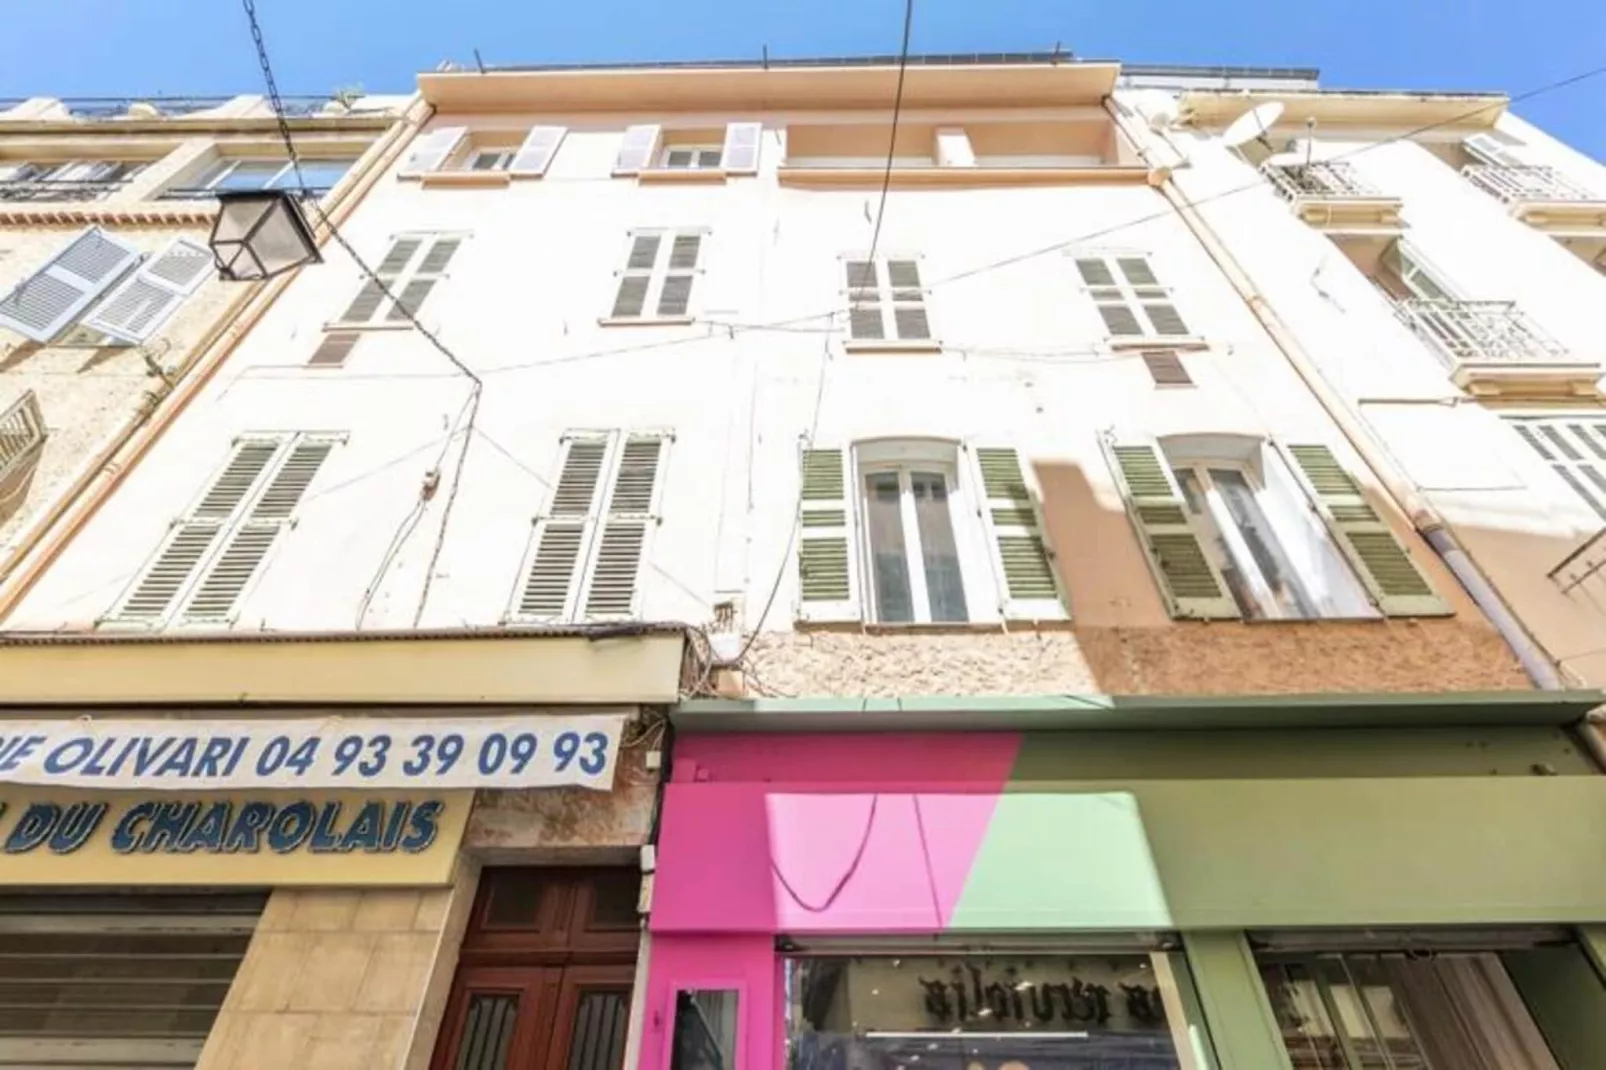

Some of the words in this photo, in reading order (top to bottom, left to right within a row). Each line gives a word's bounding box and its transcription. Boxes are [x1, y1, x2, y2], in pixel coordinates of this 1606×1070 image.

[0, 736, 47, 770] IE
[44, 736, 250, 777] OLIVARI
[256, 735, 321, 776] 04
[331, 735, 392, 776] 93
[403, 734, 464, 775] 39
[478, 732, 538, 775] 09
[553, 731, 608, 775] 93
[5, 801, 109, 853] DU
[111, 800, 443, 854] CHAROLAIS
